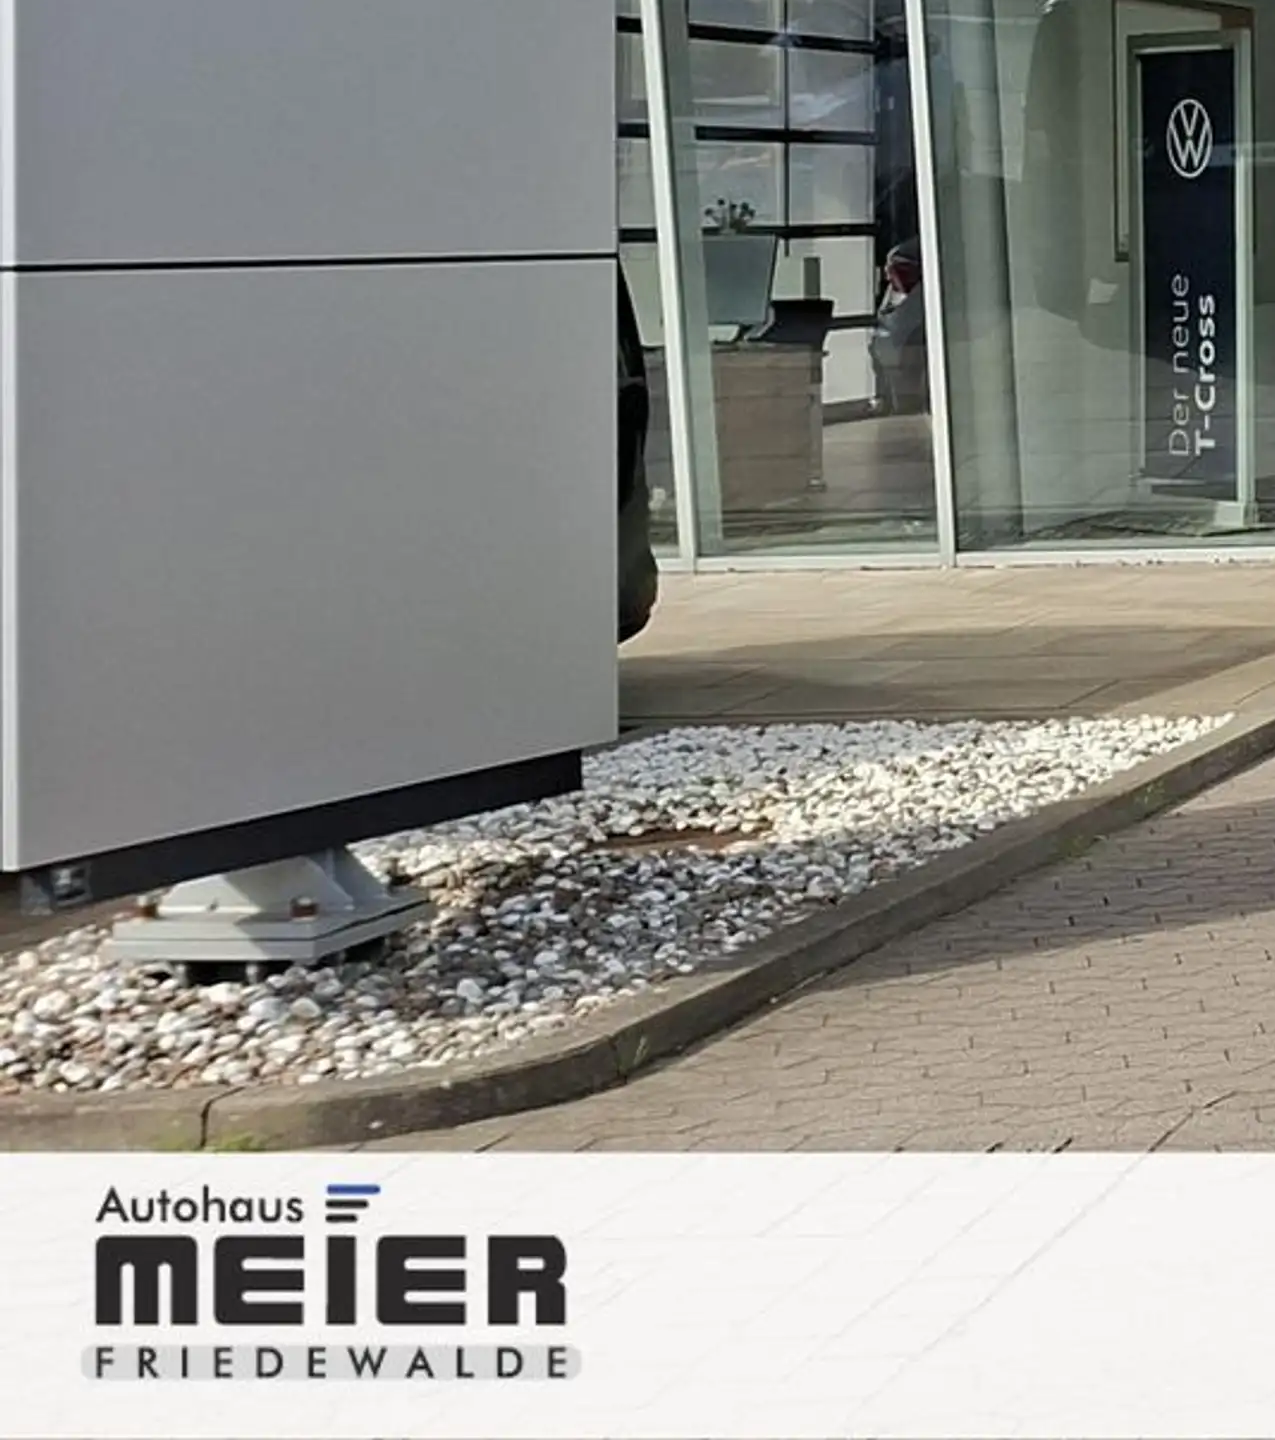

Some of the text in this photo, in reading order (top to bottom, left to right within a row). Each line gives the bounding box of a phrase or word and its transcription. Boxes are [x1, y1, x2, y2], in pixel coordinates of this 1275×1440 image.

[1169, 273, 1190, 457] Der neue
[1194, 293, 1216, 457] T-Cross
